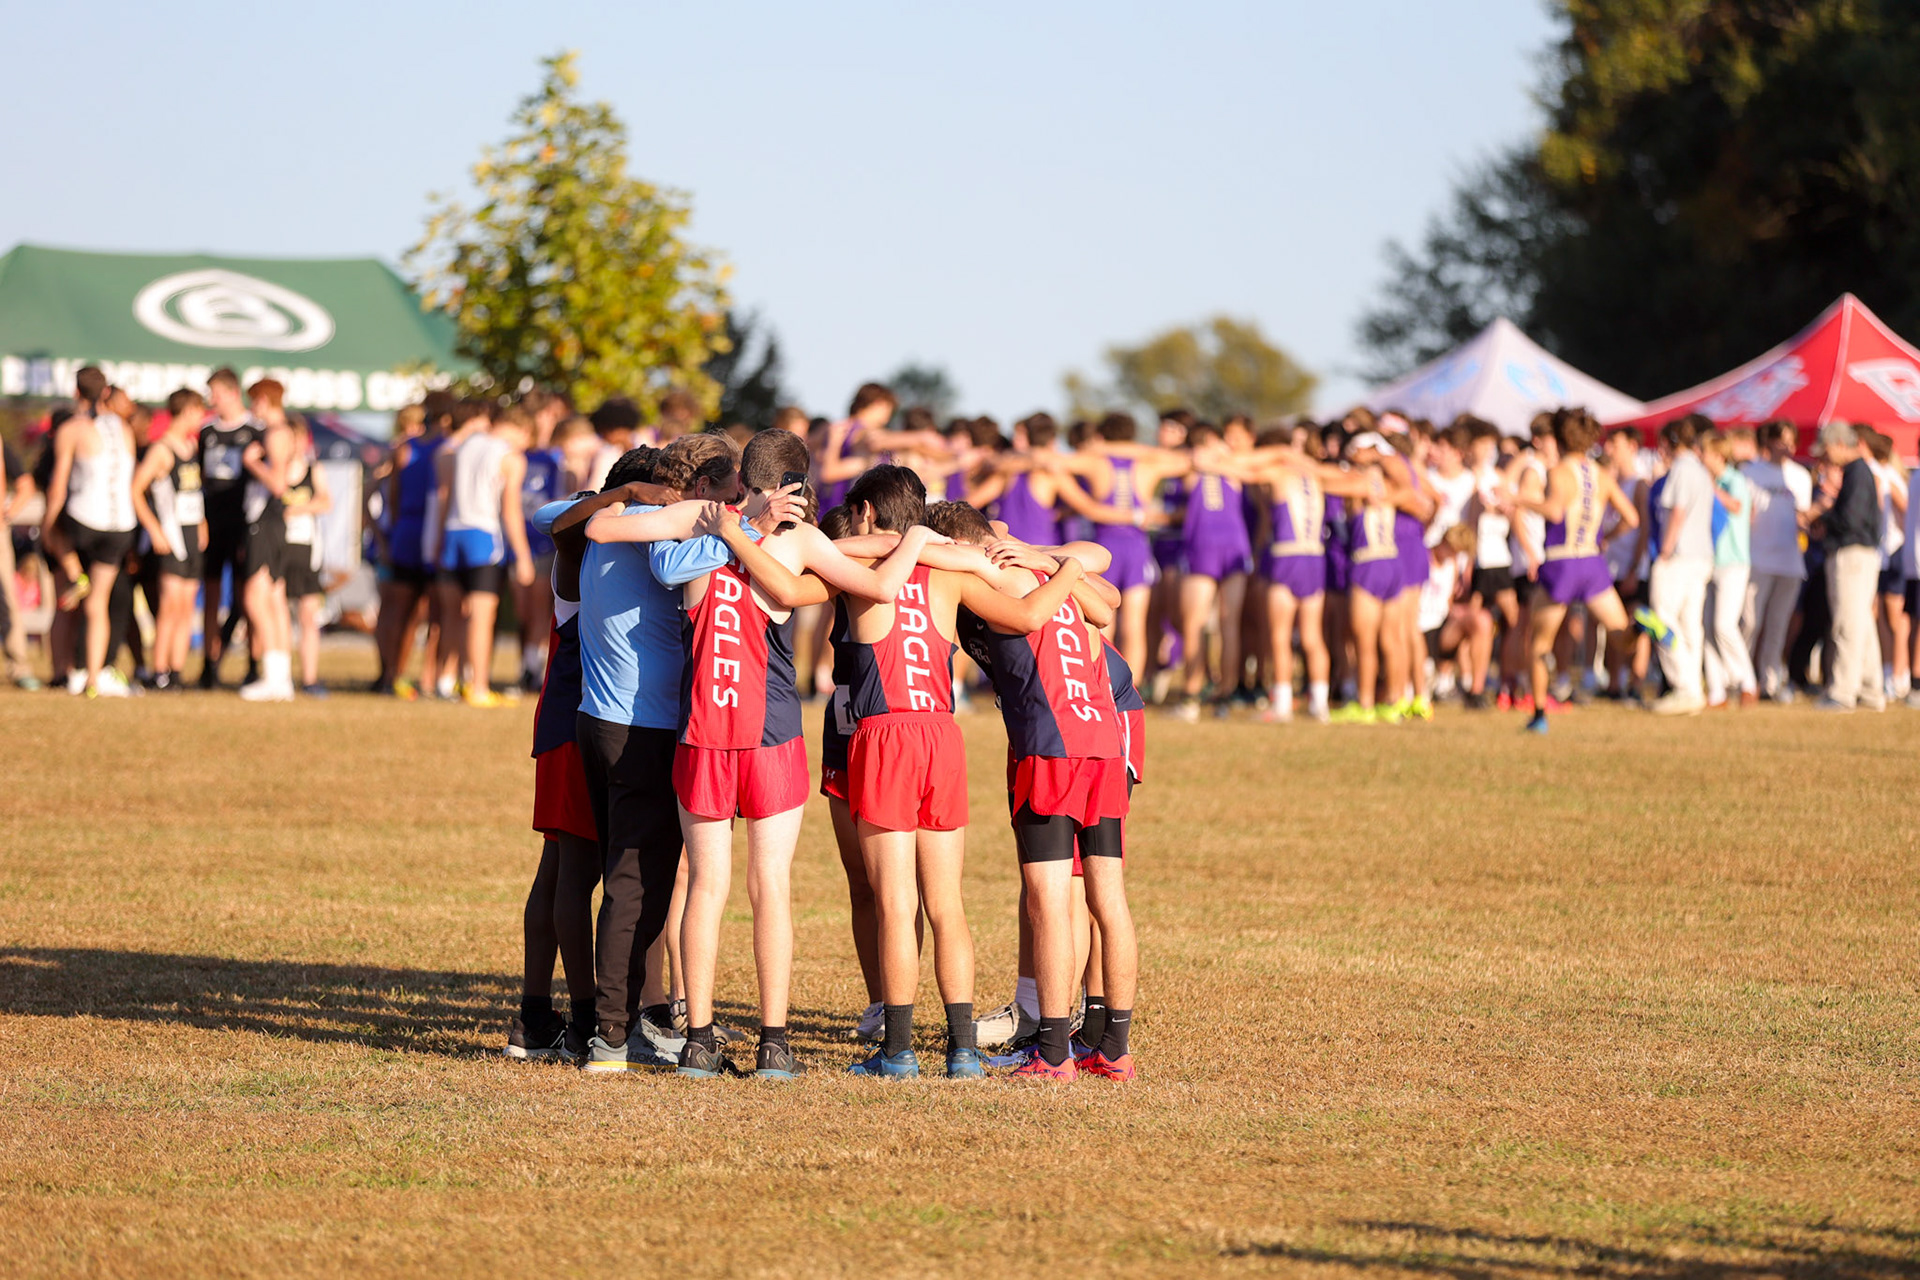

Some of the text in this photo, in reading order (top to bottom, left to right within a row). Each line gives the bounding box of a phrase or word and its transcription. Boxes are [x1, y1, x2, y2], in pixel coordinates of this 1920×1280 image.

[712, 559, 745, 709] AGLES
[898, 583, 936, 713] EAGLE
[1052, 602, 1102, 722] AGLES
[629, 1051, 661, 1065] HOKA
